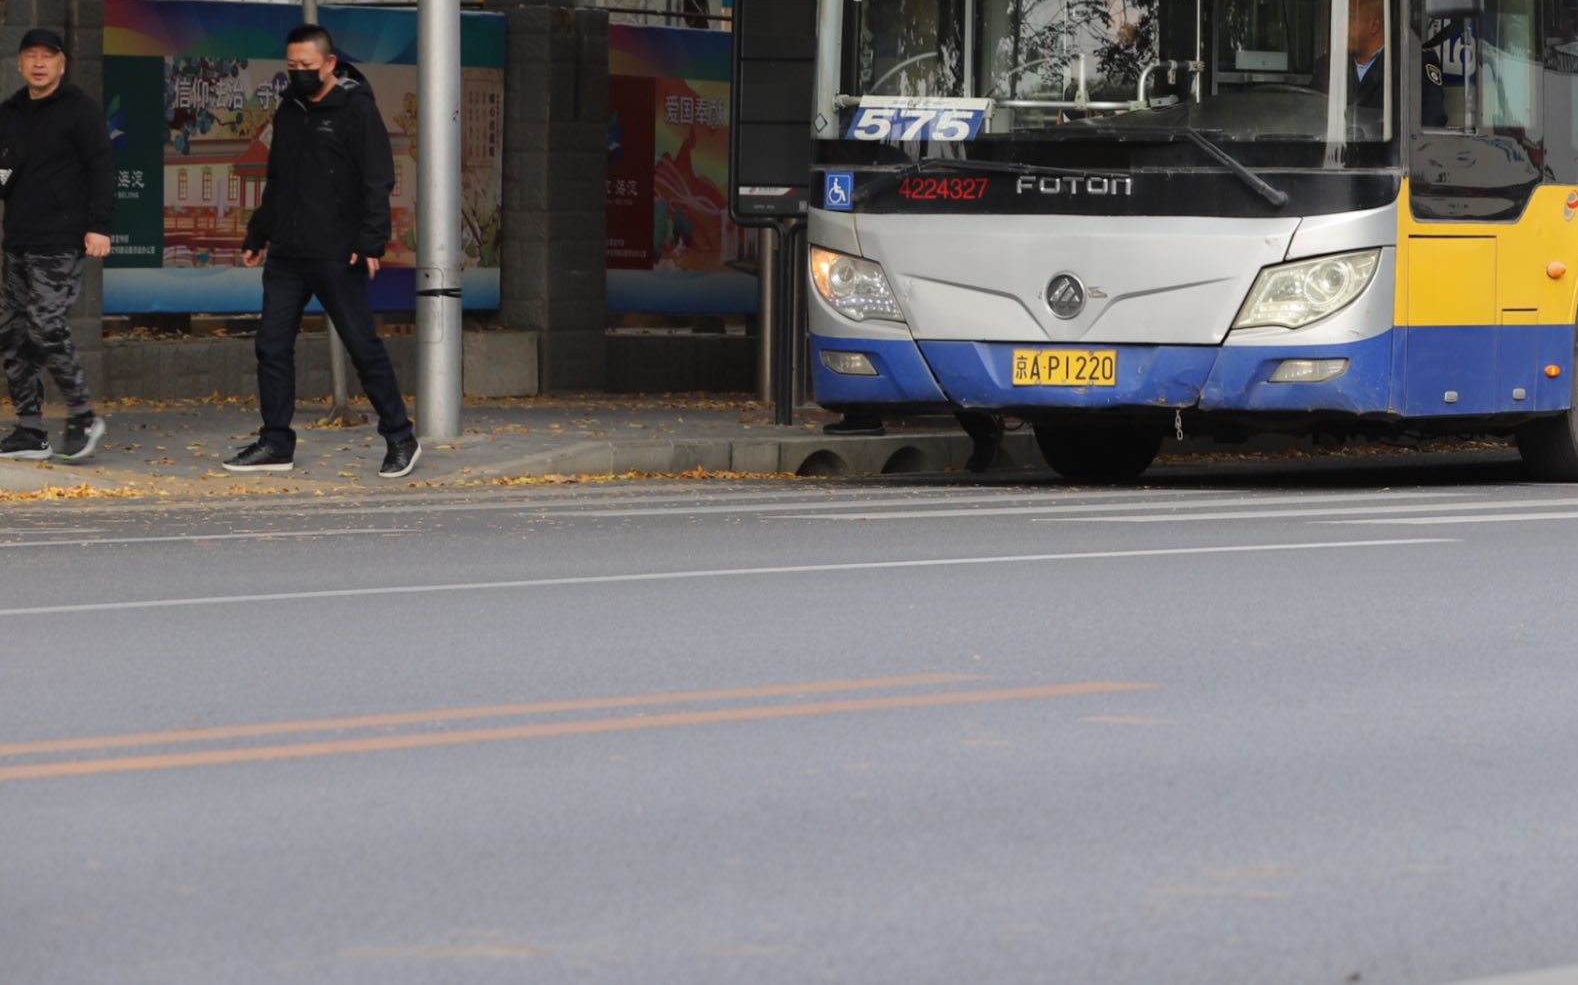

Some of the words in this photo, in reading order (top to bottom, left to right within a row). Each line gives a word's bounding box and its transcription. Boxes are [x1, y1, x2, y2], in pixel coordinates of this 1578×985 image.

[174, 77, 244, 110] 信仰法治
[664, 94, 725, 127] 爱国奉献
[852, 109, 974, 141] 575
[898, 177, 989, 200] 4224327
[1016, 176, 1132, 196] FOTON
